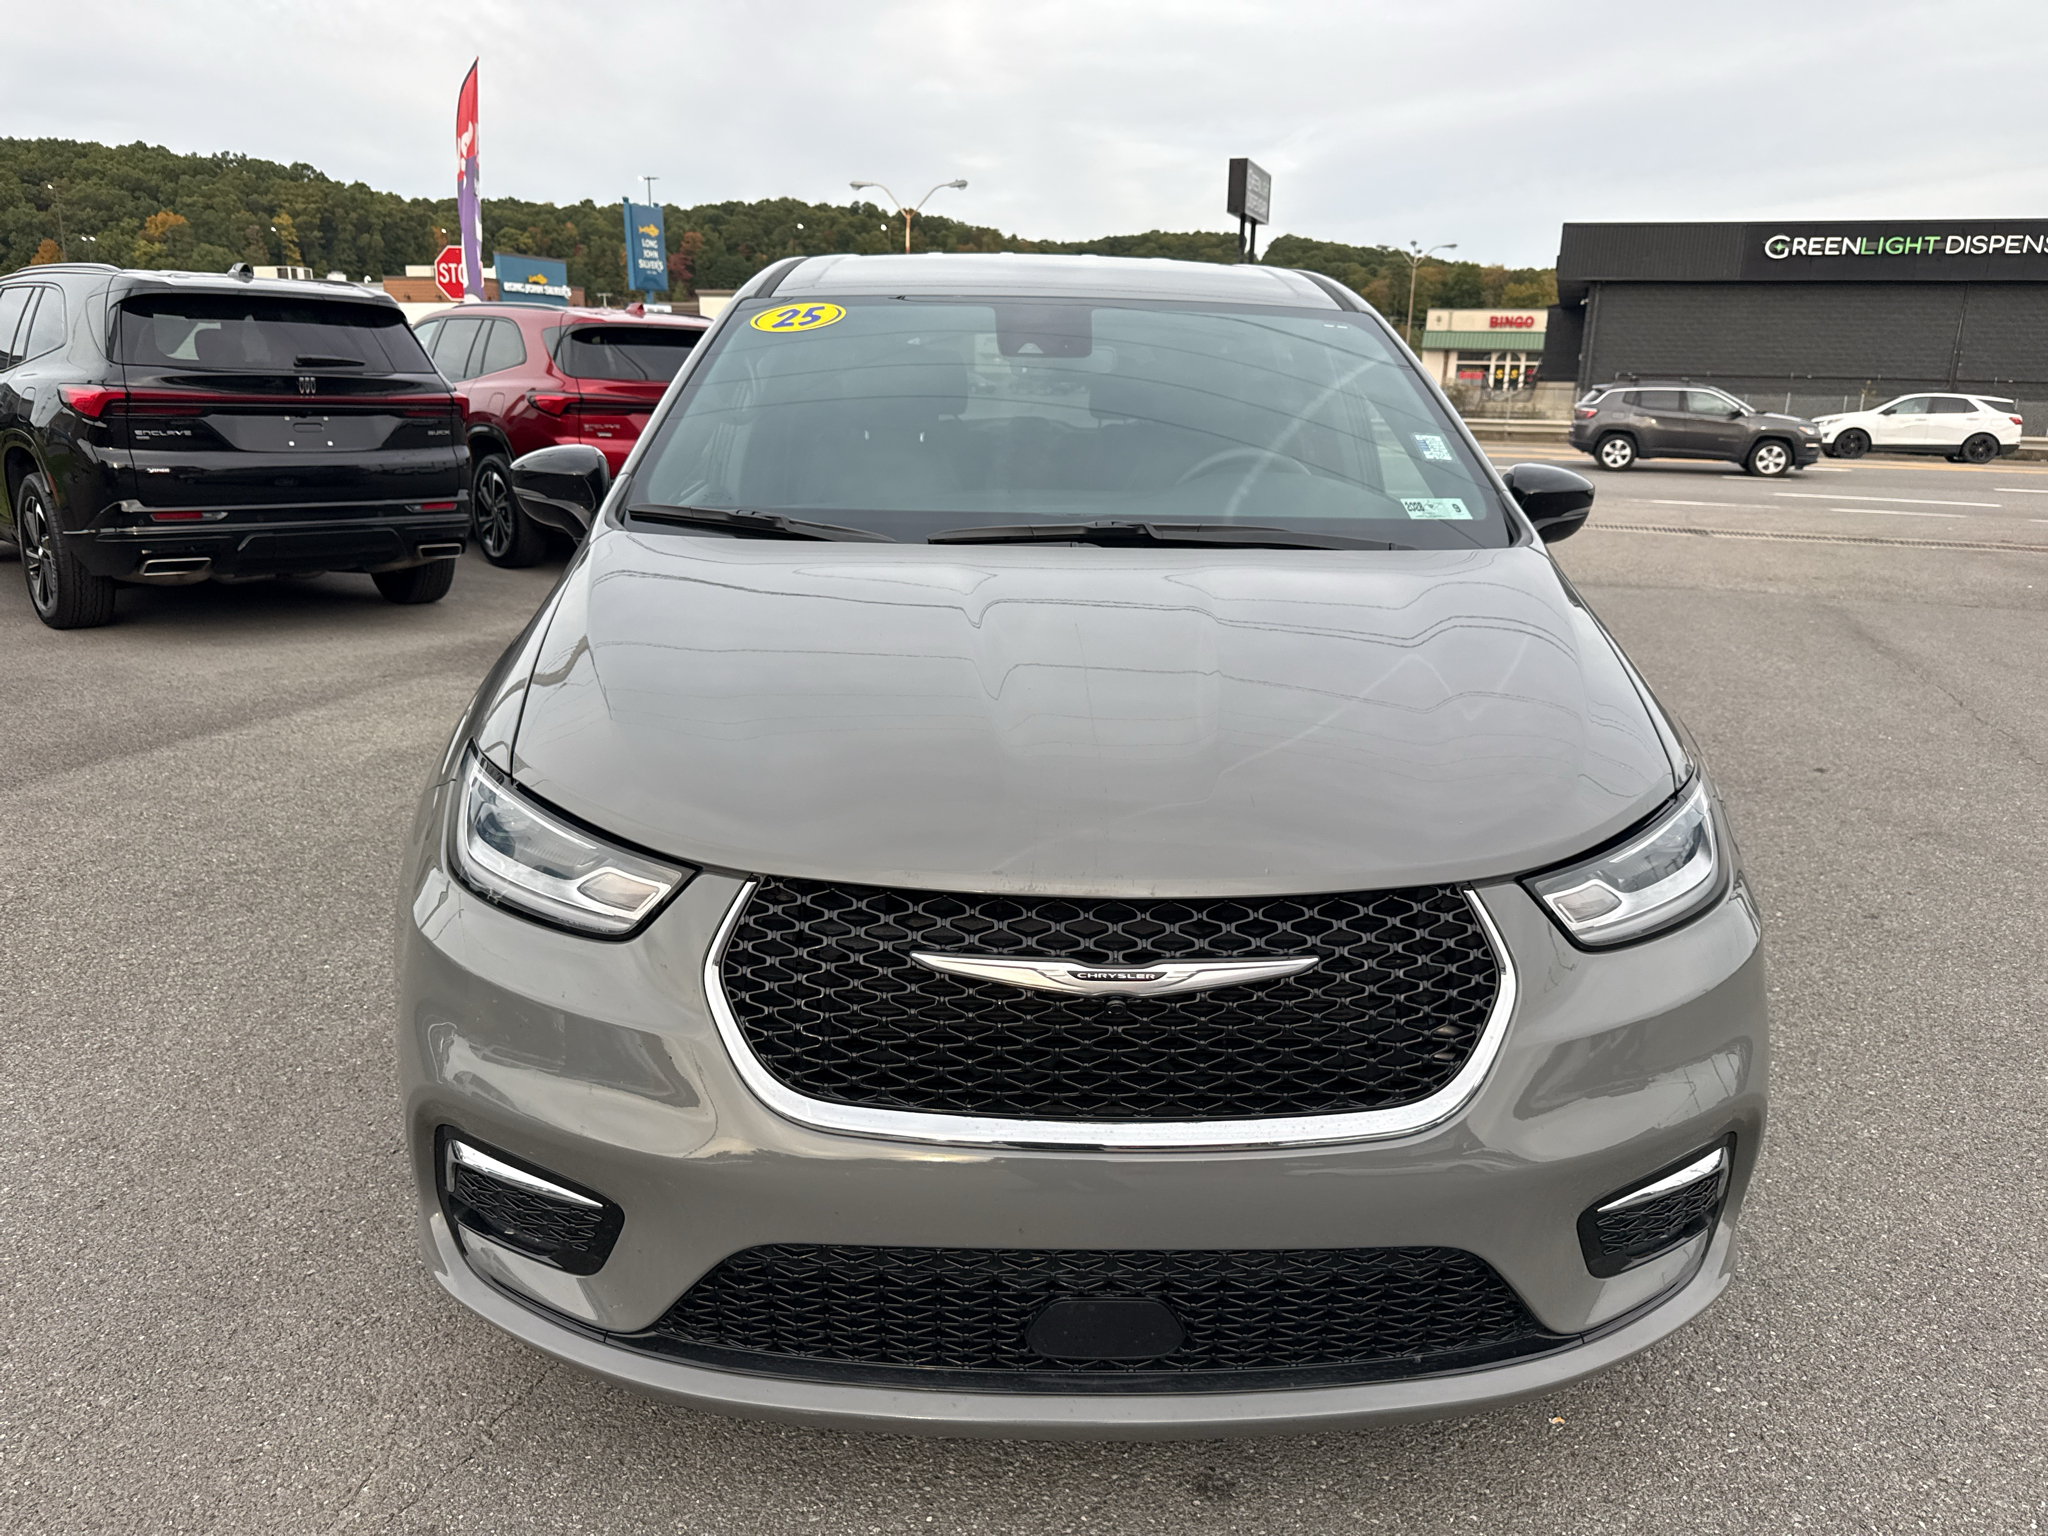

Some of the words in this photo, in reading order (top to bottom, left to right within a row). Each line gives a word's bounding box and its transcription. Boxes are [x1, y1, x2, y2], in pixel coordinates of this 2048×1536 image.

[641, 238, 658, 249] LONG
[1764, 234, 1941, 259] GREENLIGHT
[1945, 234, 2048, 254] DISPEN
[643, 249, 659, 259] JOHN
[638, 259, 664, 273] SILVER'S
[439, 262, 466, 284] STO
[771, 306, 825, 328] 25
[1489, 316, 1534, 328] BINGO
[1452, 503, 1462, 513] 9
